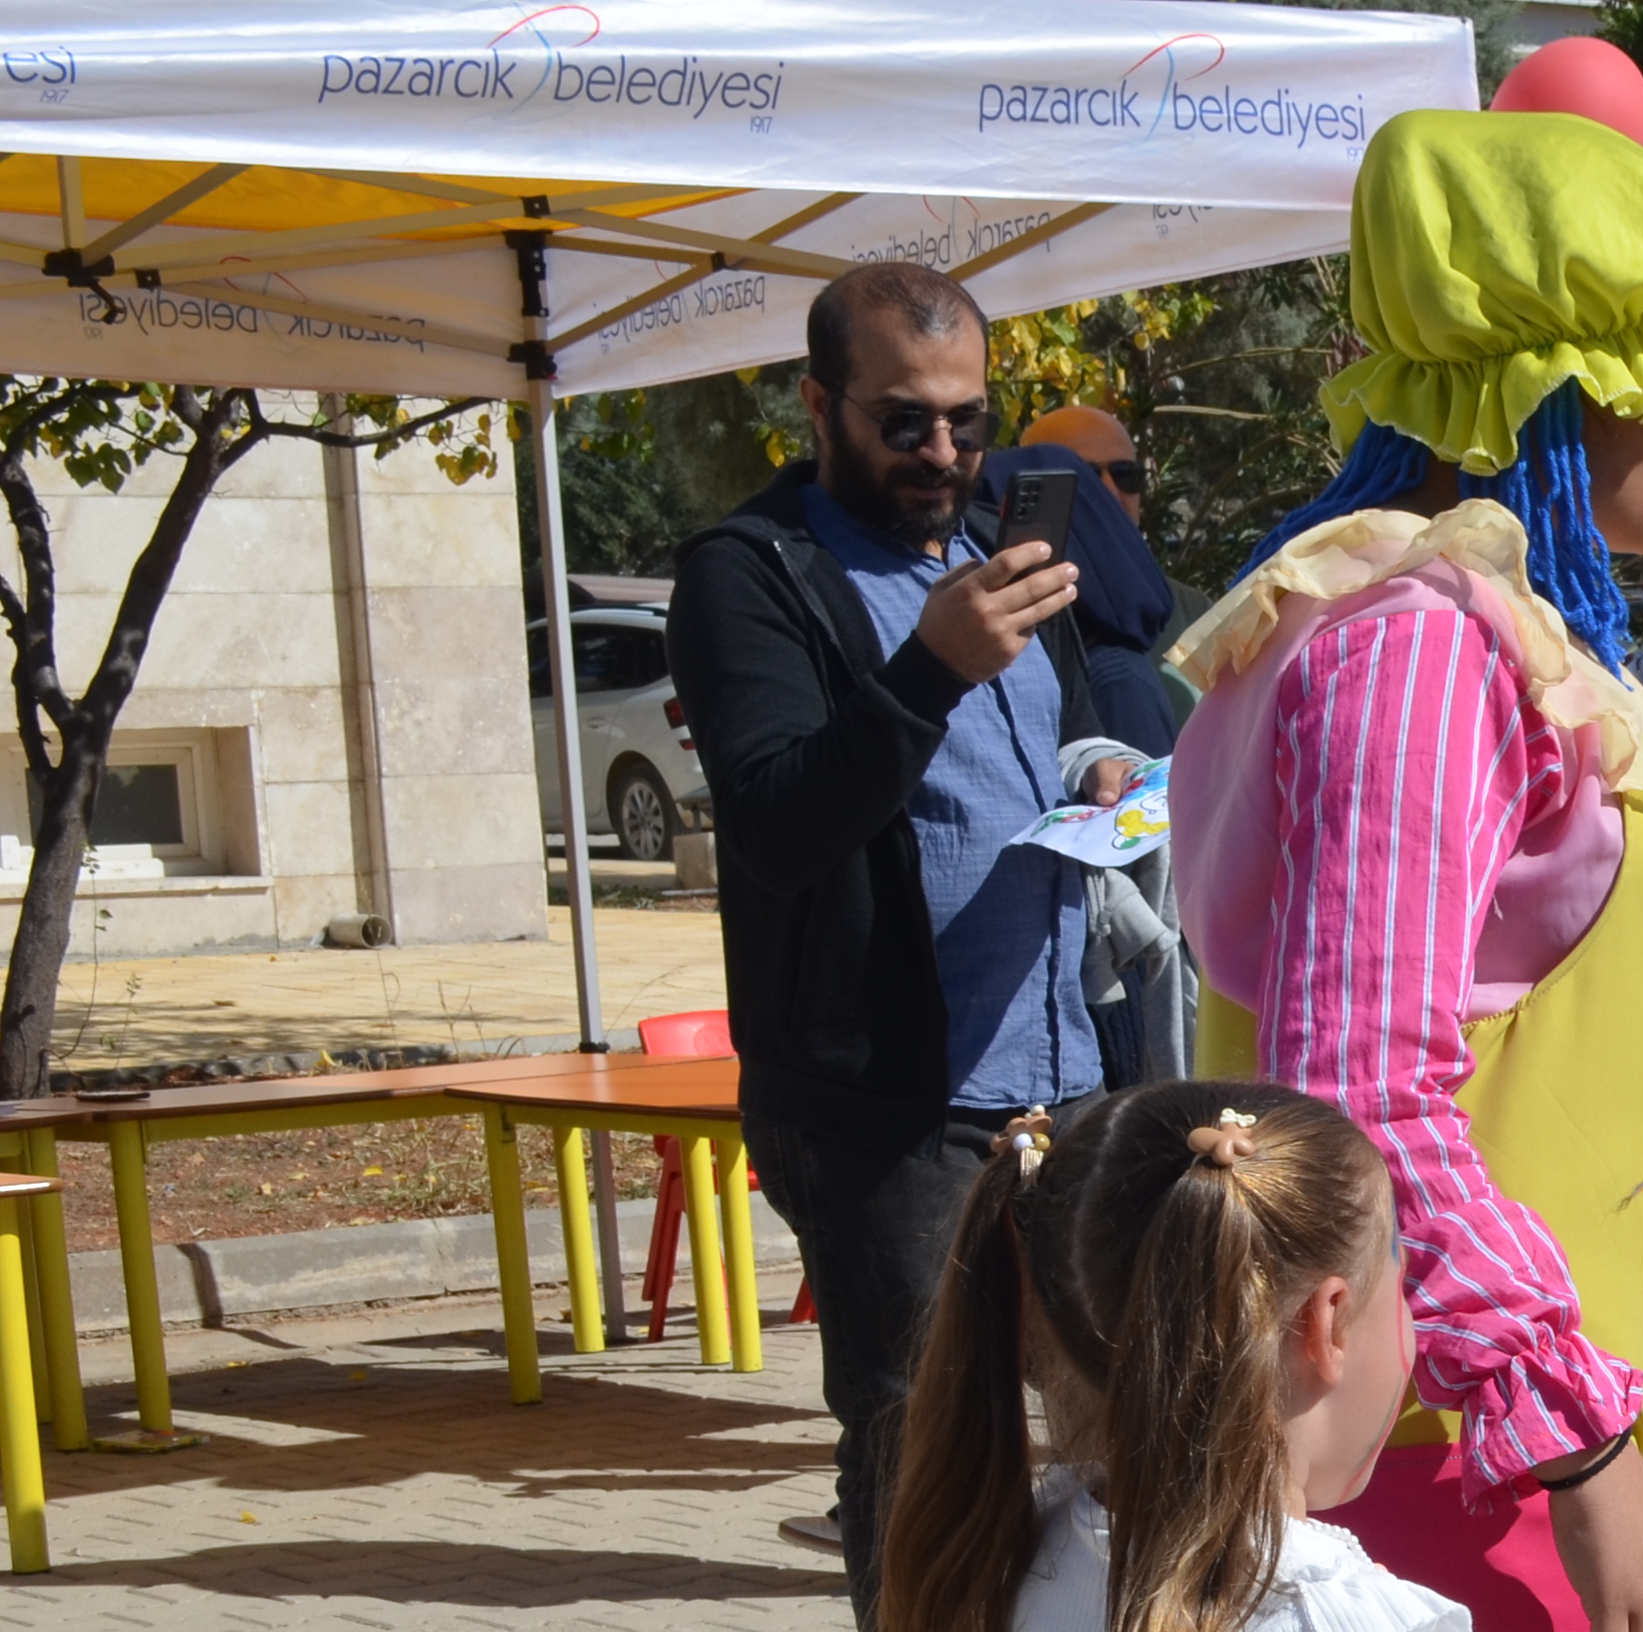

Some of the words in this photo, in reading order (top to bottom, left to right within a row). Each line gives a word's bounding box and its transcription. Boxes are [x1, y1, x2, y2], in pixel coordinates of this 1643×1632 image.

[317, 47, 518, 104] pazarcık
[552, 51, 786, 119] belediyesi
[978, 79, 1141, 133] pazarcık
[1172, 81, 1366, 149] belediyesi
[749, 115, 773, 134] 1917
